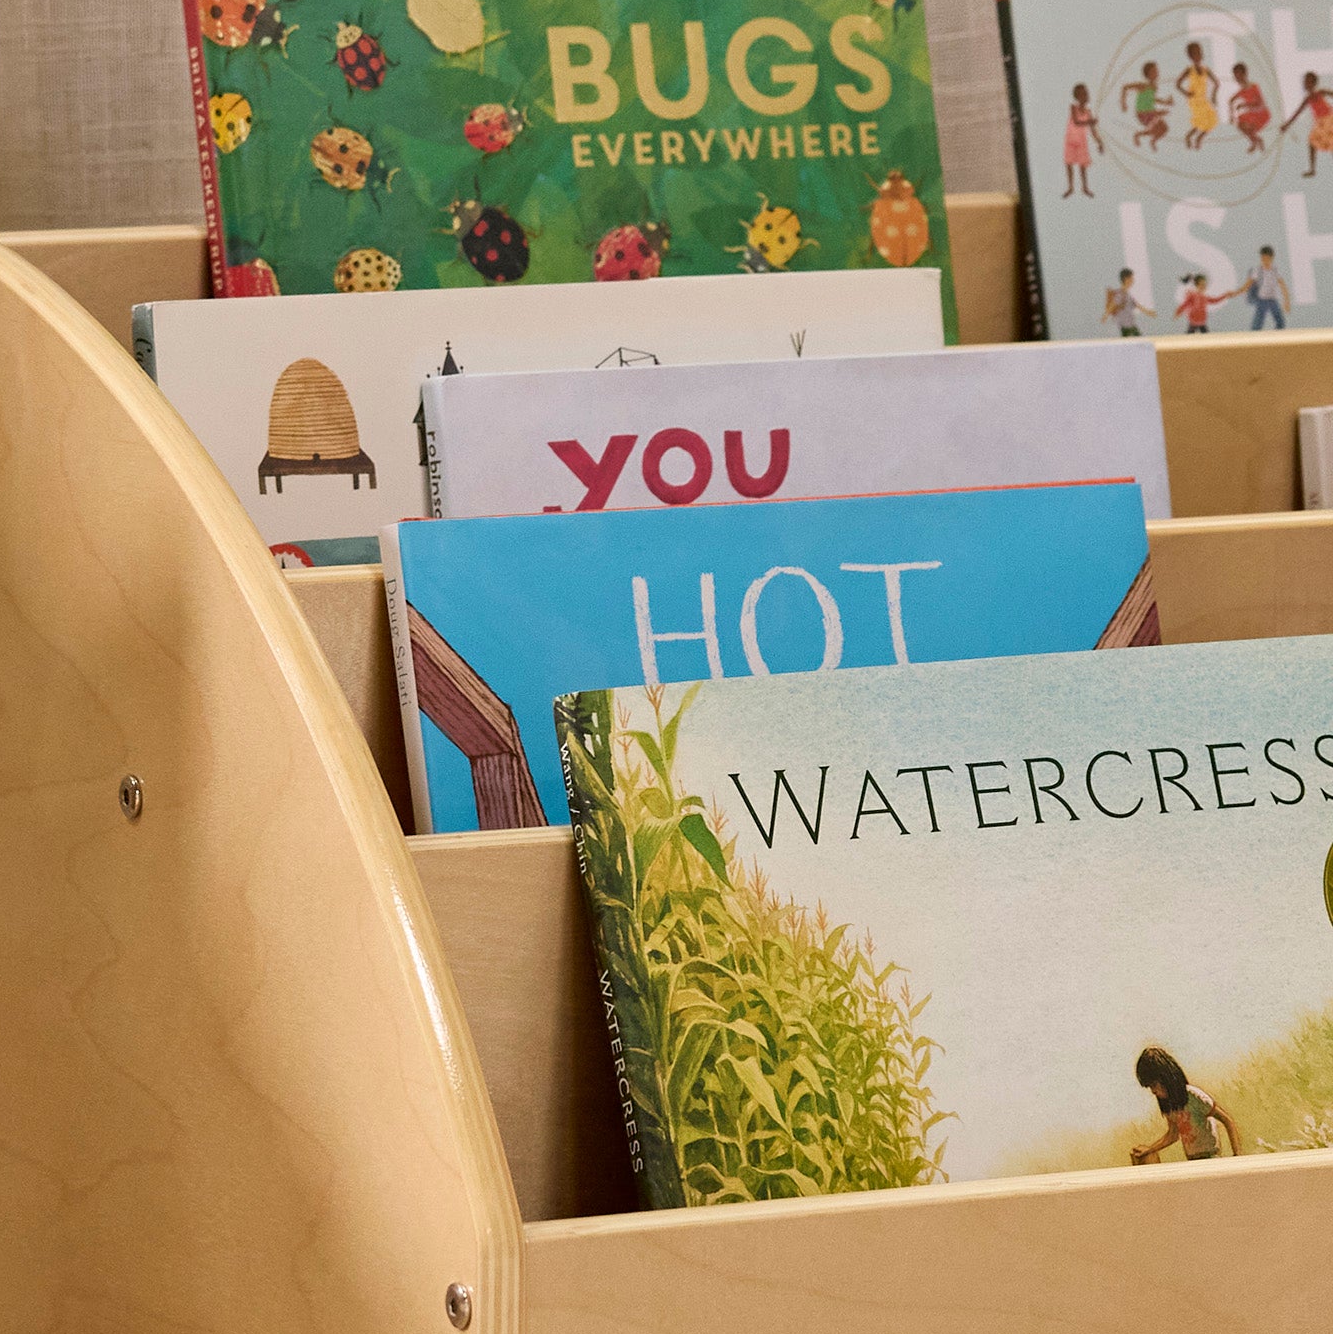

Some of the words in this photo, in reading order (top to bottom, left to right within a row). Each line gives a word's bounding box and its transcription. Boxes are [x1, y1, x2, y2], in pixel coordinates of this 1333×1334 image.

[546, 14, 893, 124] BUGS
[189, 46, 206, 128] BRITTA
[199, 138, 224, 292] TECKENTRUP
[571, 121, 881, 168] EVERYWHERE
[1118, 197, 1237, 311] IS
[386, 577, 401, 639] Doug
[394, 645, 412, 707] Salati
[632, 561, 943, 686] HOT
[560, 740, 575, 801] Wang
[573, 823, 588, 874] Chin
[599, 969, 644, 1174] WATERCRESS
